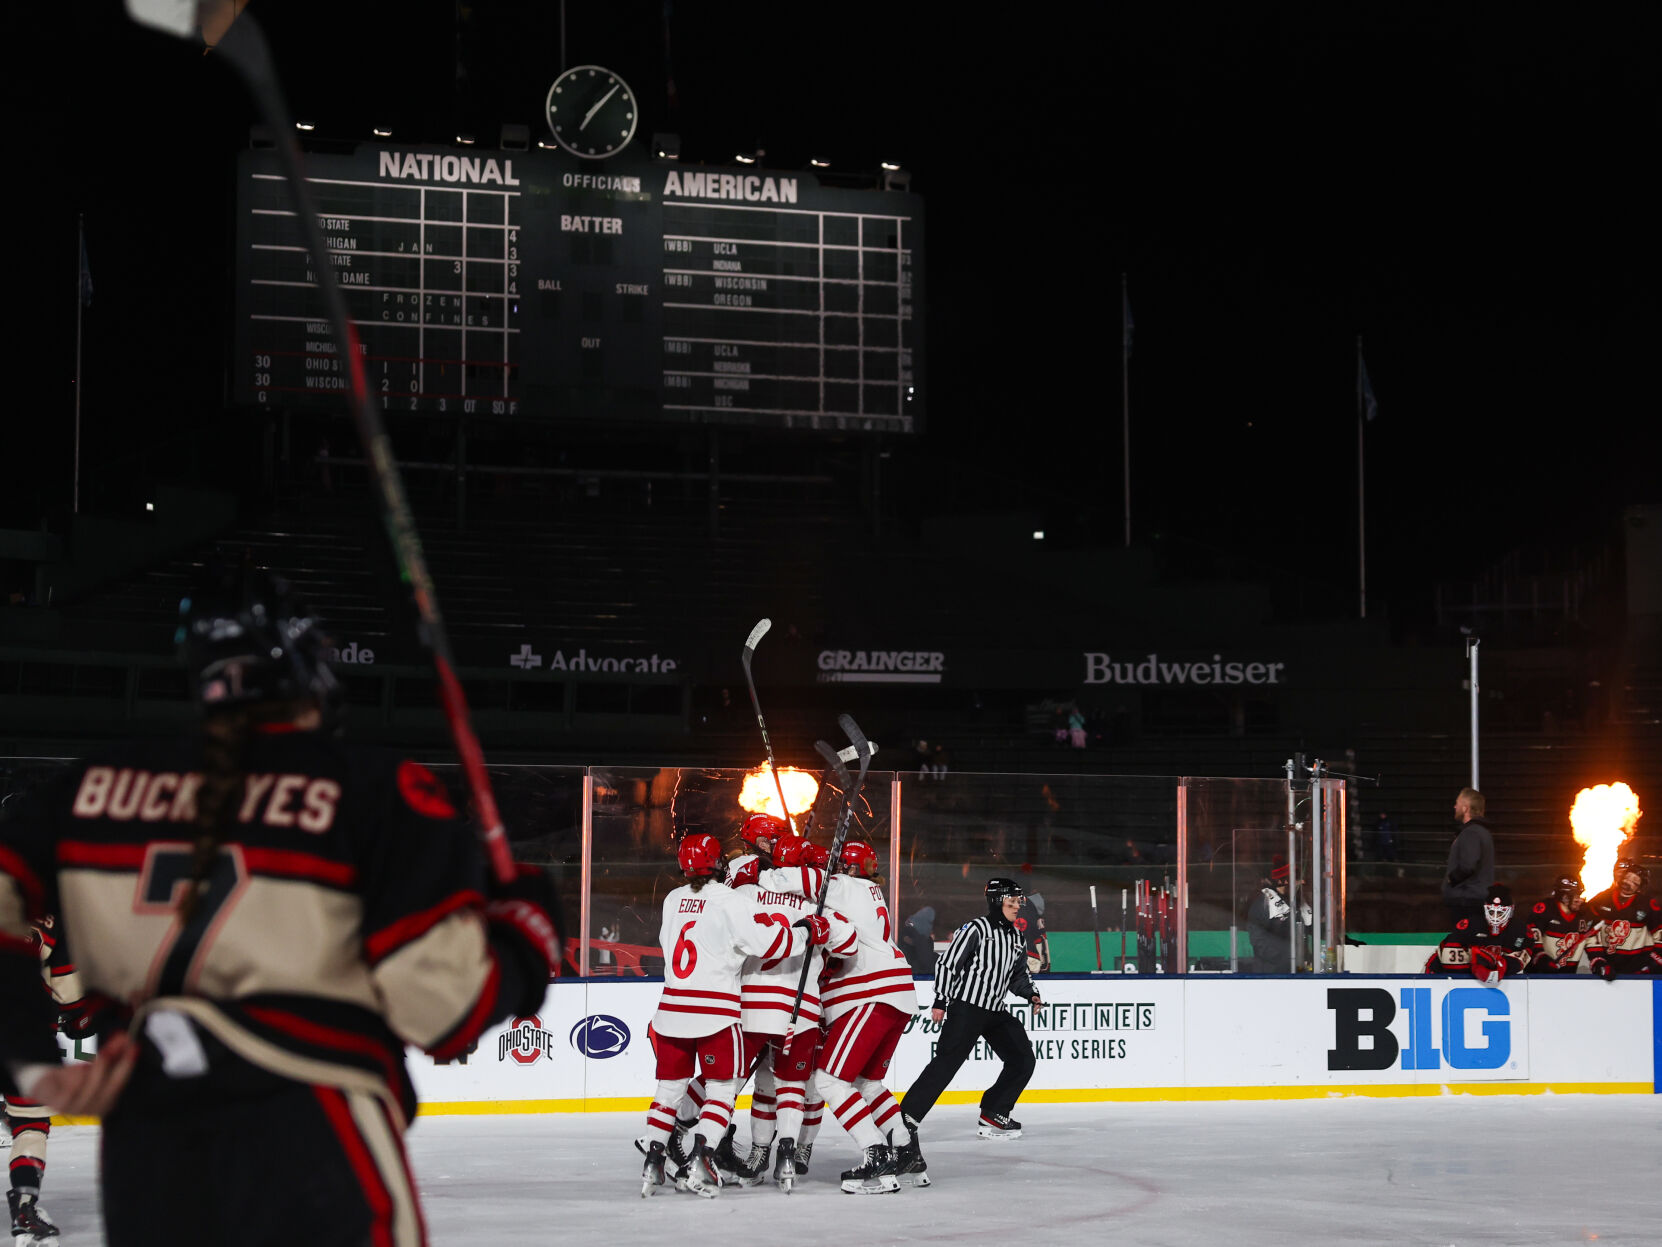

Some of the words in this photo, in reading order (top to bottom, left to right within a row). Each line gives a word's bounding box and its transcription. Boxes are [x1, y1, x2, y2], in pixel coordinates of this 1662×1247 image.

[379, 151, 520, 186] NATIONAL
[562, 173, 641, 193] OFFICIALS
[663, 170, 797, 204] AMERICAN
[327, 219, 350, 231] STATE
[560, 215, 623, 235] BATTER
[324, 236, 357, 249] HIGAN
[509, 230, 517, 242] 4
[510, 247, 517, 259] 3
[713, 243, 737, 255] UCLA
[453, 261, 461, 273] 3
[510, 264, 517, 277] 3
[342, 272, 370, 285] DAME
[538, 279, 562, 290] BALL
[714, 277, 767, 291] WISCONSIN
[509, 282, 517, 294] 4
[616, 283, 649, 295] STRIKE
[713, 294, 752, 306] OREGON
[305, 341, 338, 354] MICHIGA
[581, 337, 600, 348] OUT
[714, 345, 738, 357] UCLA
[255, 356, 270, 368] 30
[306, 358, 330, 370] OHIO
[255, 374, 270, 386] 30
[306, 376, 345, 389] WISCON
[382, 379, 389, 391] 2
[411, 380, 418, 392] 0
[410, 398, 417, 410] 2
[439, 399, 446, 411] 3
[551, 650, 677, 673] Advocate
[817, 650, 944, 672] GRAINGER
[1083, 652, 1285, 685] Budweiser
[72, 766, 341, 833] BUCKYES
[678, 898, 706, 914] EDEN
[132, 840, 251, 999] 7
[672, 920, 698, 980] 6
[1449, 951, 1465, 963] 35
[1012, 1004, 1155, 1030] ONFINES
[970, 1040, 994, 1060] EN
[1030, 1040, 1064, 1060] KEY
[1072, 1040, 1126, 1060] SERIES
